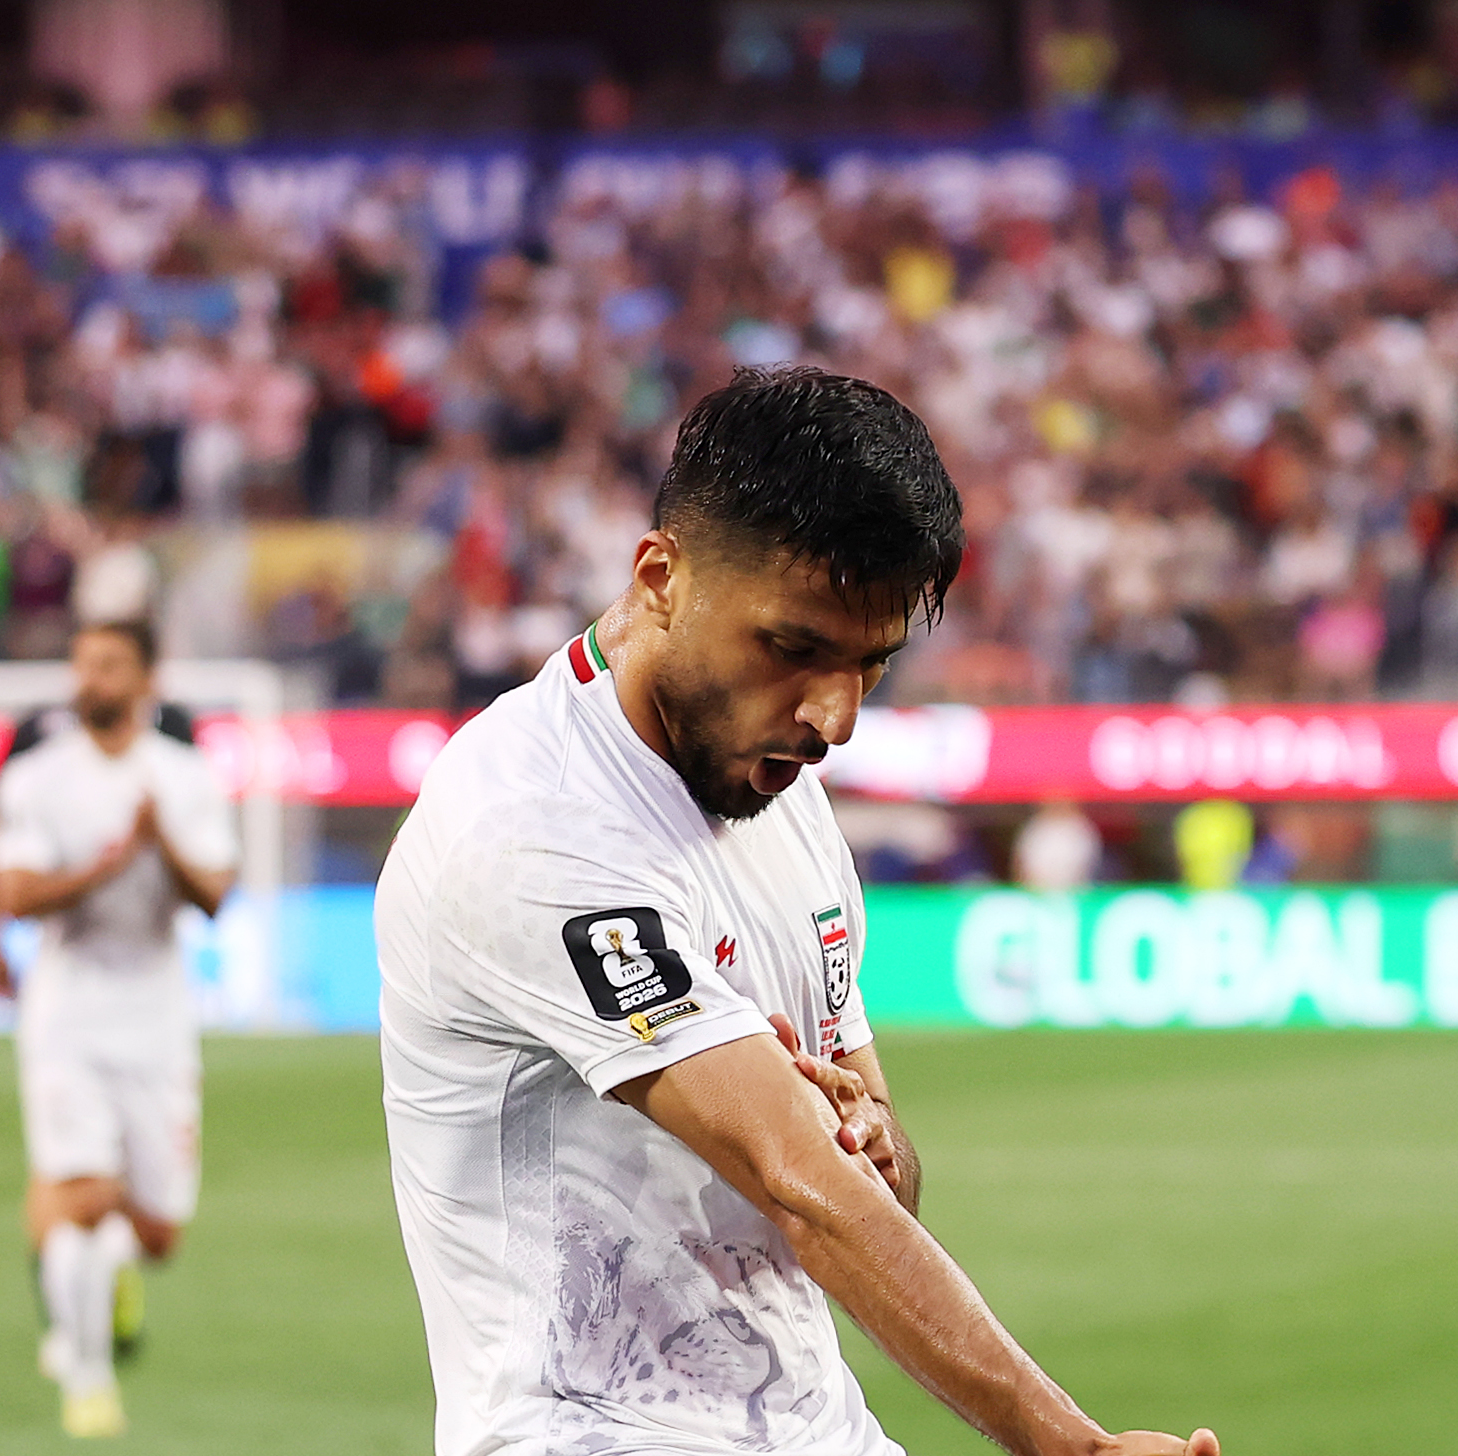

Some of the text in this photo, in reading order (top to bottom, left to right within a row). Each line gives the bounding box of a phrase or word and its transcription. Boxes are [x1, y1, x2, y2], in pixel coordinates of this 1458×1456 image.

[954, 889, 1415, 1028] GLOBAL
[621, 965, 644, 979] FIFA
[615, 975, 662, 1000] WORLD CUP
[618, 983, 668, 1012] 2026
[648, 1002, 693, 1023] DEBUT
